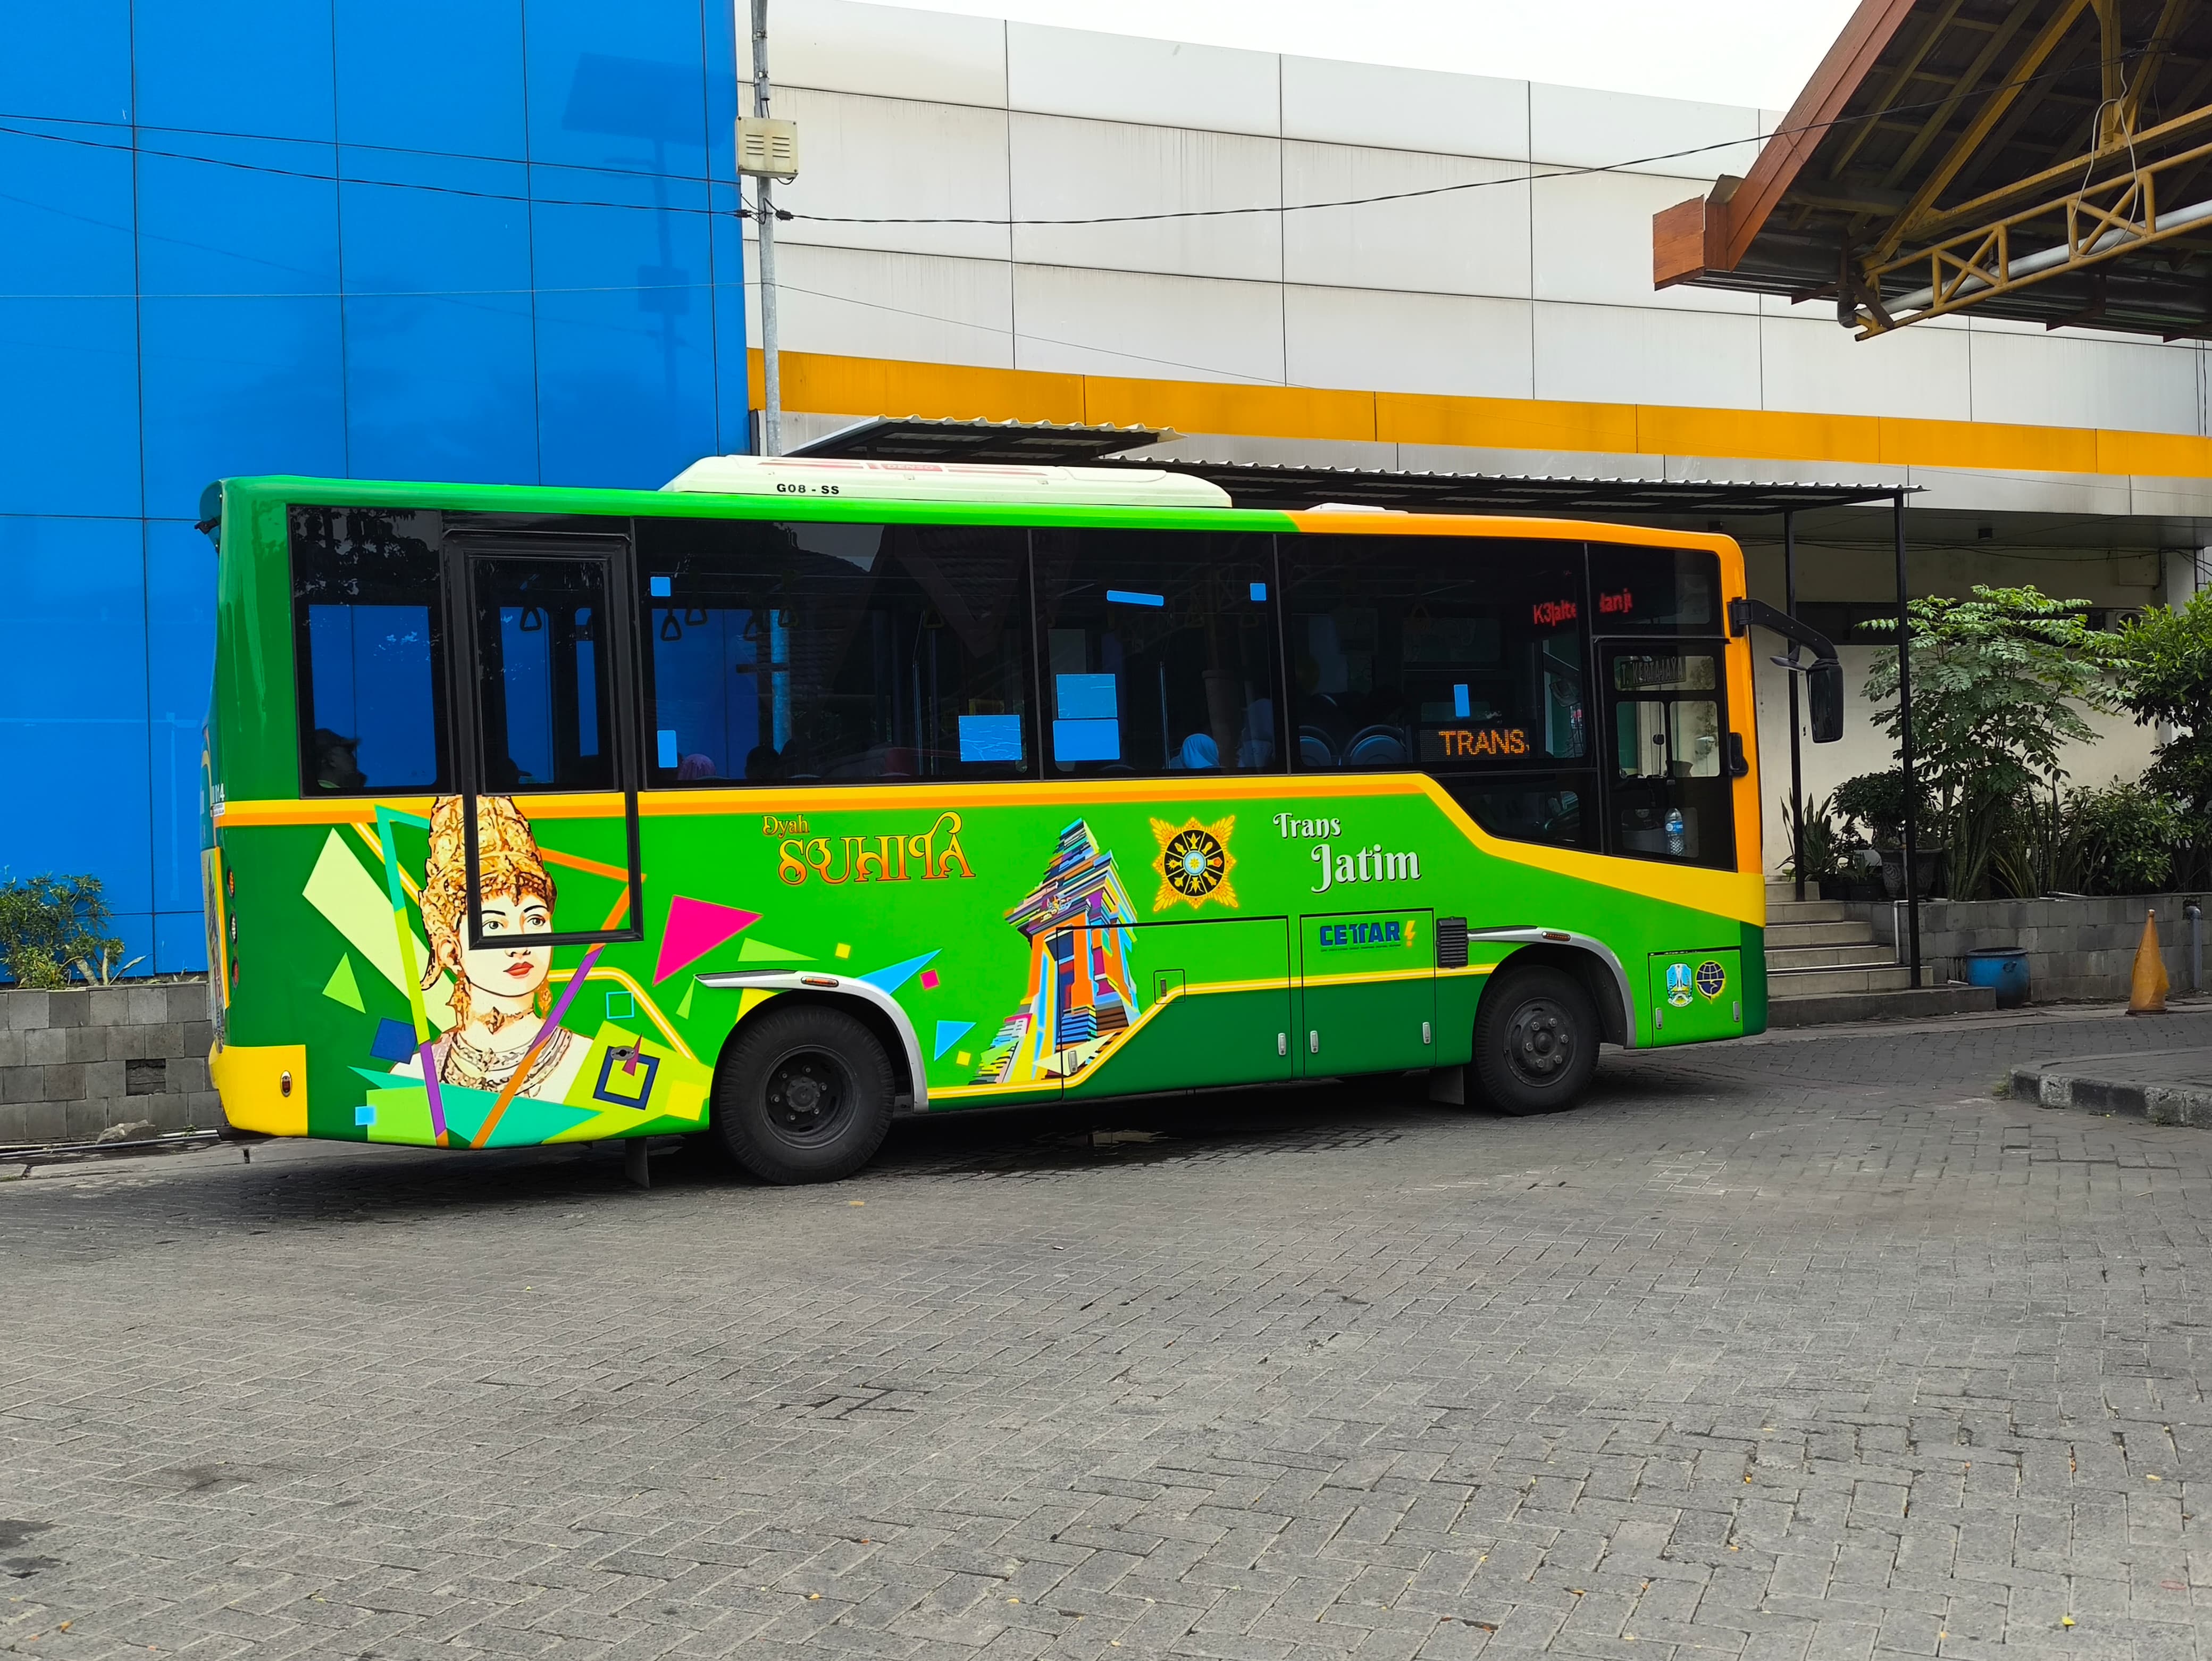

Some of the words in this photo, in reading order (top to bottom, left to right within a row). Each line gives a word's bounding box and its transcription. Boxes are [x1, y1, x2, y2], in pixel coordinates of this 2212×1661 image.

[776, 483, 807, 494] G08
[821, 485, 840, 495] SS
[1438, 729, 1526, 756] TRANS
[761, 814, 810, 839] Dyah
[1272, 812, 1342, 839] Trans
[778, 811, 976, 886] SUHITA
[1310, 843, 1422, 894] Jatim
